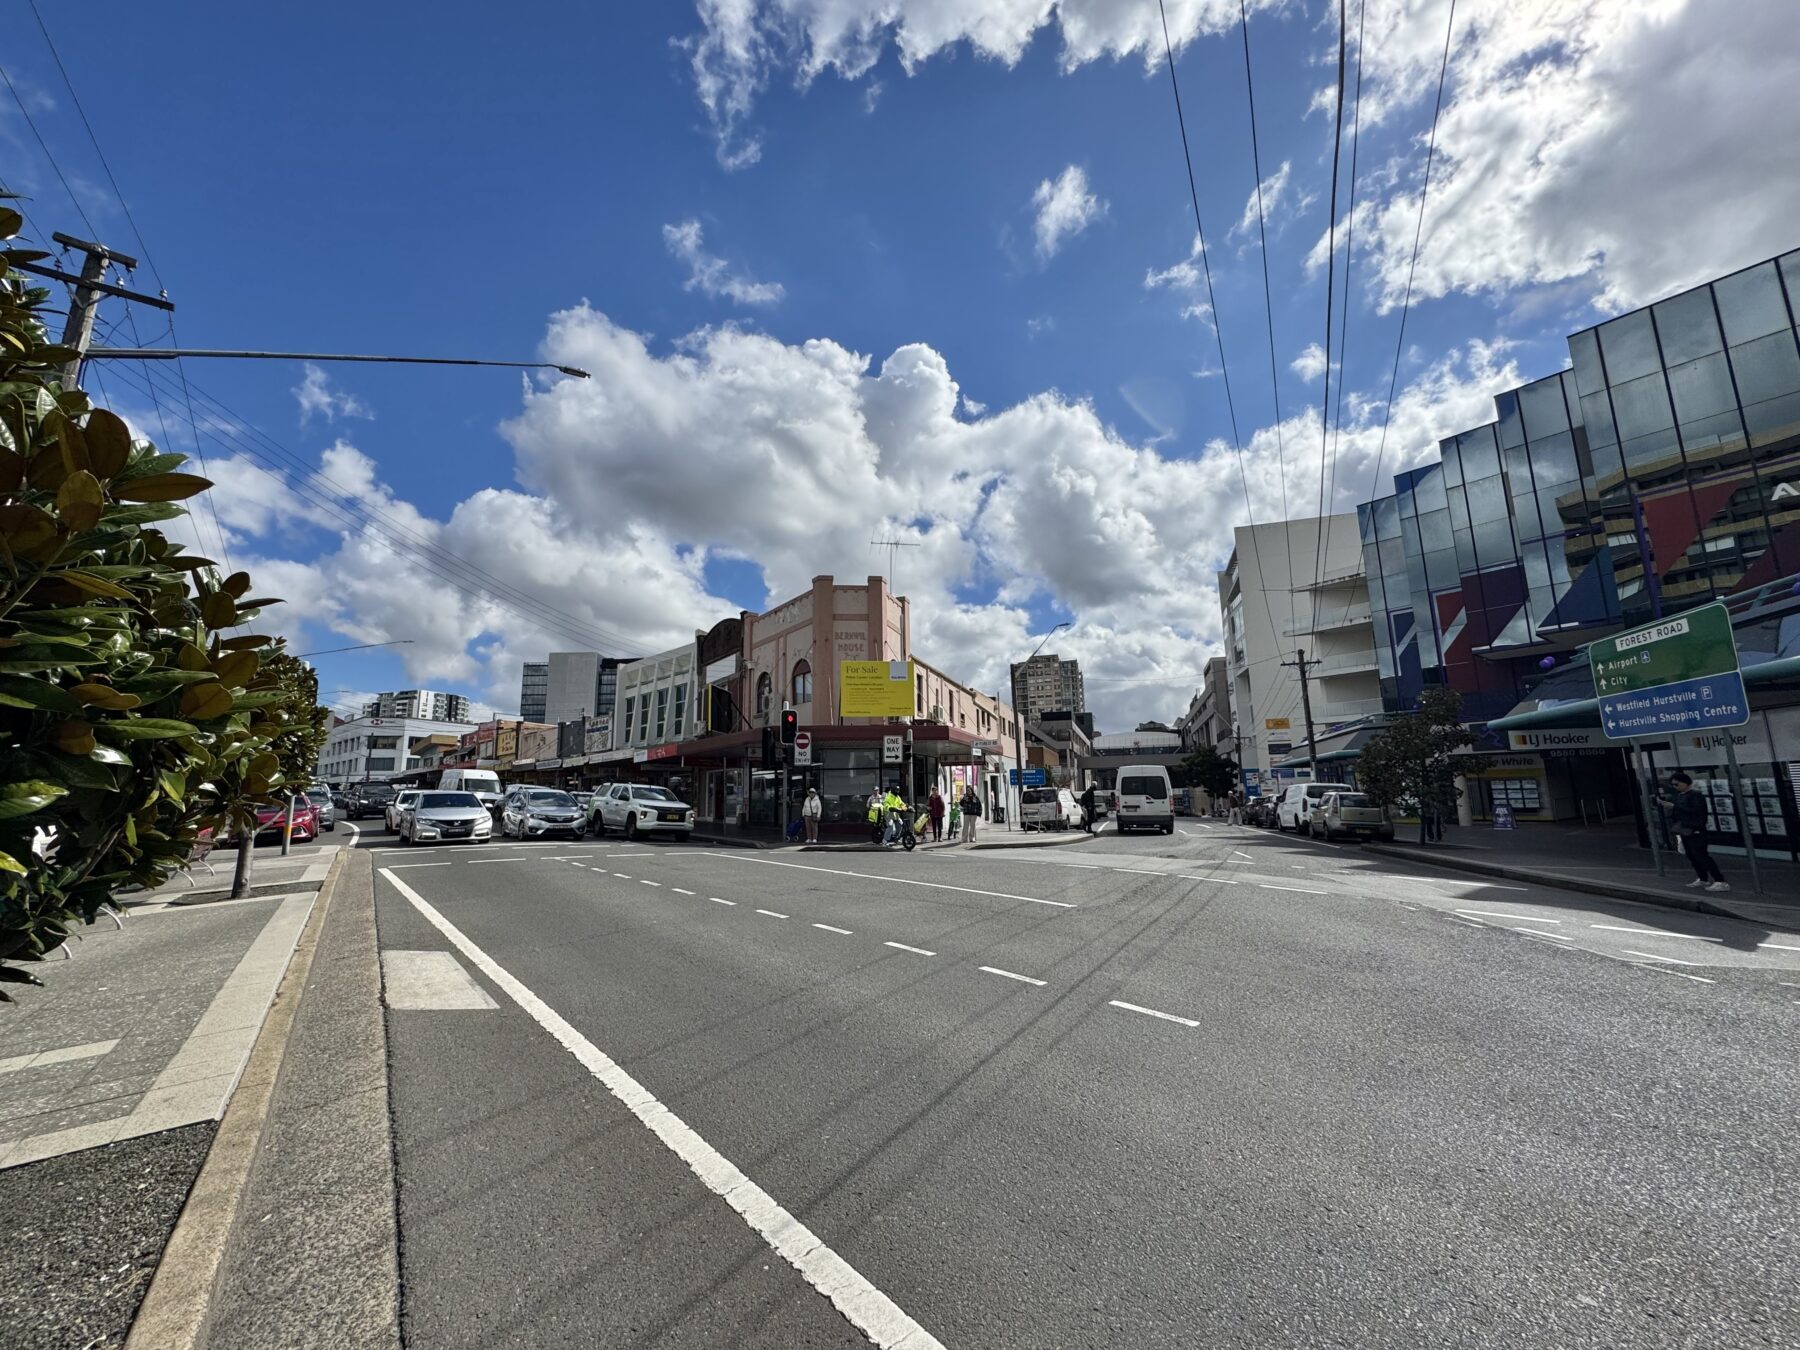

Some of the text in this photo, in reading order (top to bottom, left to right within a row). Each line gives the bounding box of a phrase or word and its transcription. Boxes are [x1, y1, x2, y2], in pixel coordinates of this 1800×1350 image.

[1770, 482, 1800, 501] A
[1620, 622, 1683, 648] FOREST ROAD
[838, 643, 864, 652] HOUSE
[846, 665, 878, 673] For Sale
[1608, 655, 1638, 671] Airport
[1610, 675, 1628, 687] City
[1616, 698, 1650, 712] Westfield
[1653, 691, 1697, 706] Hurstville
[1619, 703, 1738, 728] Hurstville Shopping Centre
[1529, 732, 1590, 747] LJ Hooker
[1702, 734, 1747, 751] LJ Hoker
[1501, 757, 1534, 766] White
